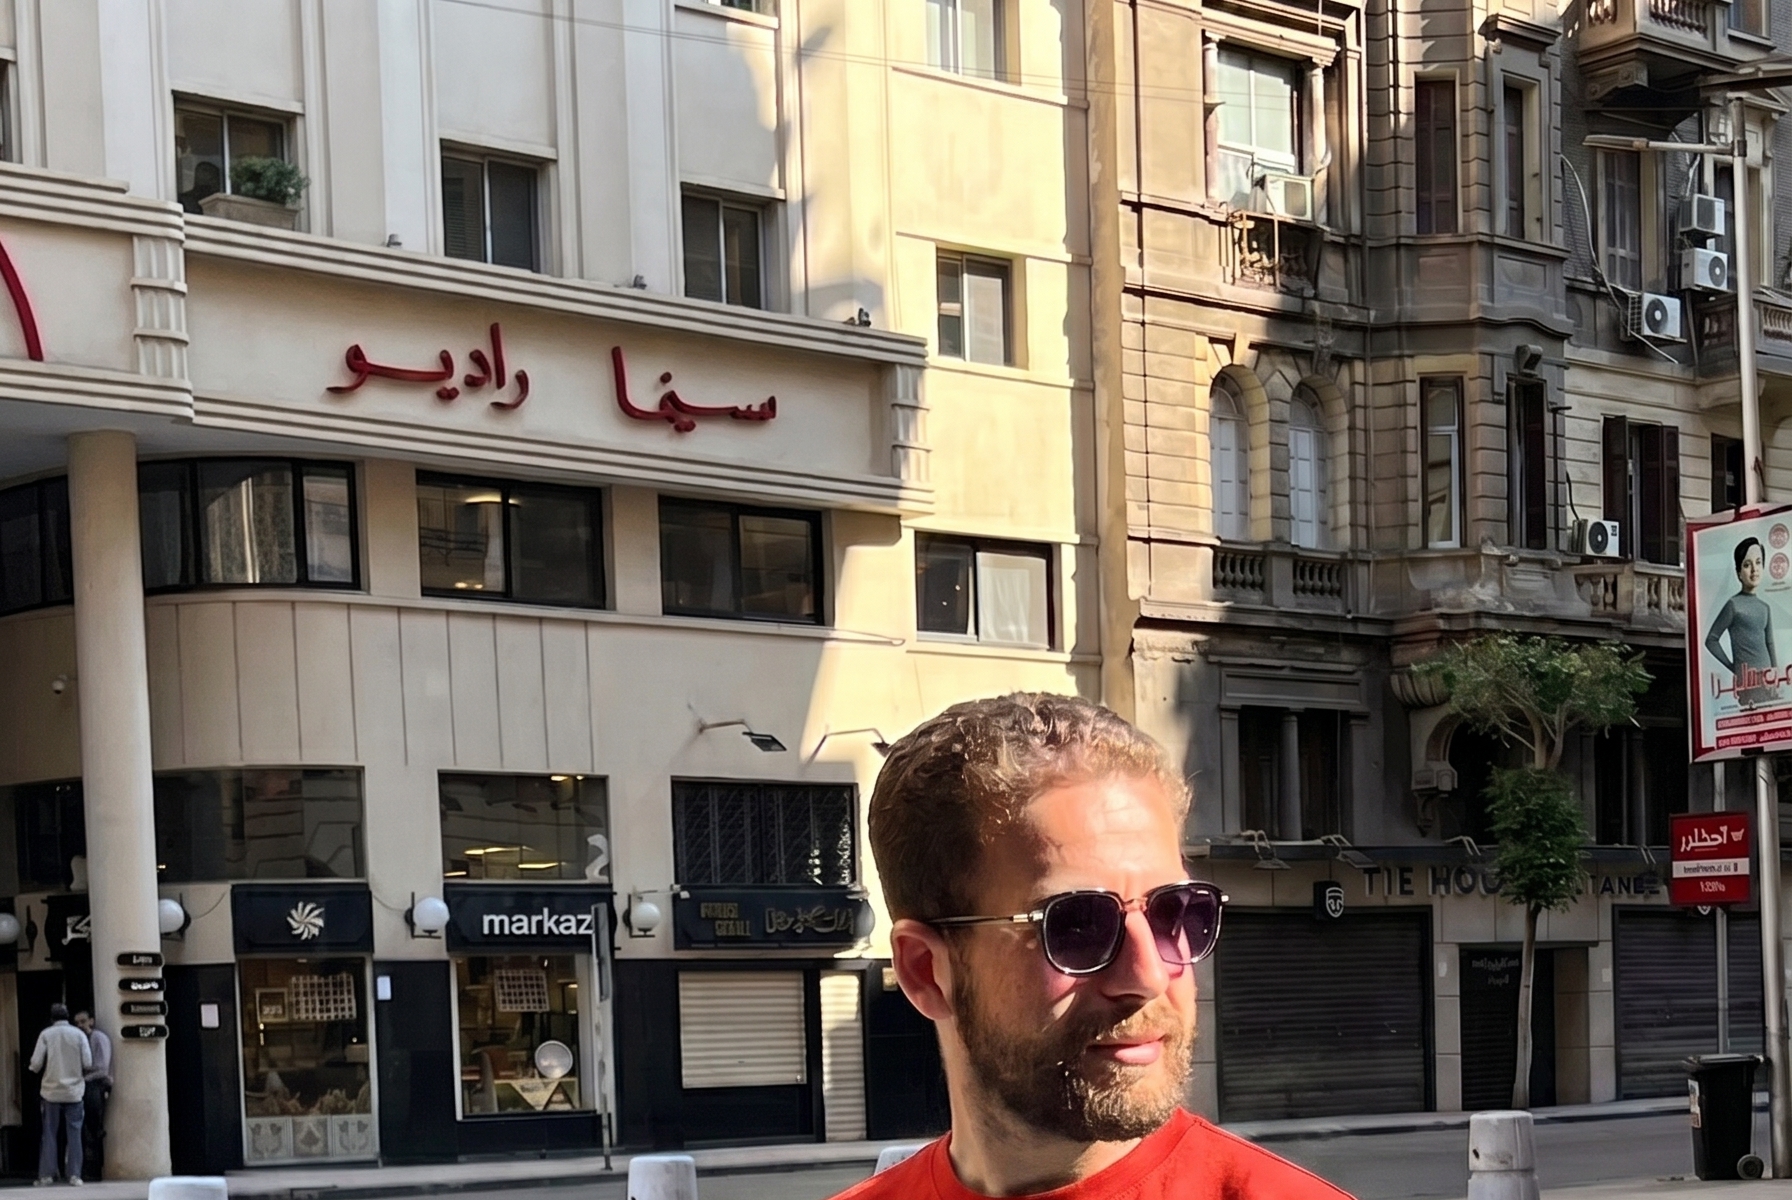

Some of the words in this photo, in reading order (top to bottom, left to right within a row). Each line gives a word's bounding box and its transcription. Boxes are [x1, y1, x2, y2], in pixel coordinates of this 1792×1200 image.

[326, 322, 529, 410] راديو
[611, 346, 776, 433] سينما
[1363, 866, 1414, 896] TIE
[483, 907, 594, 935] markaz
